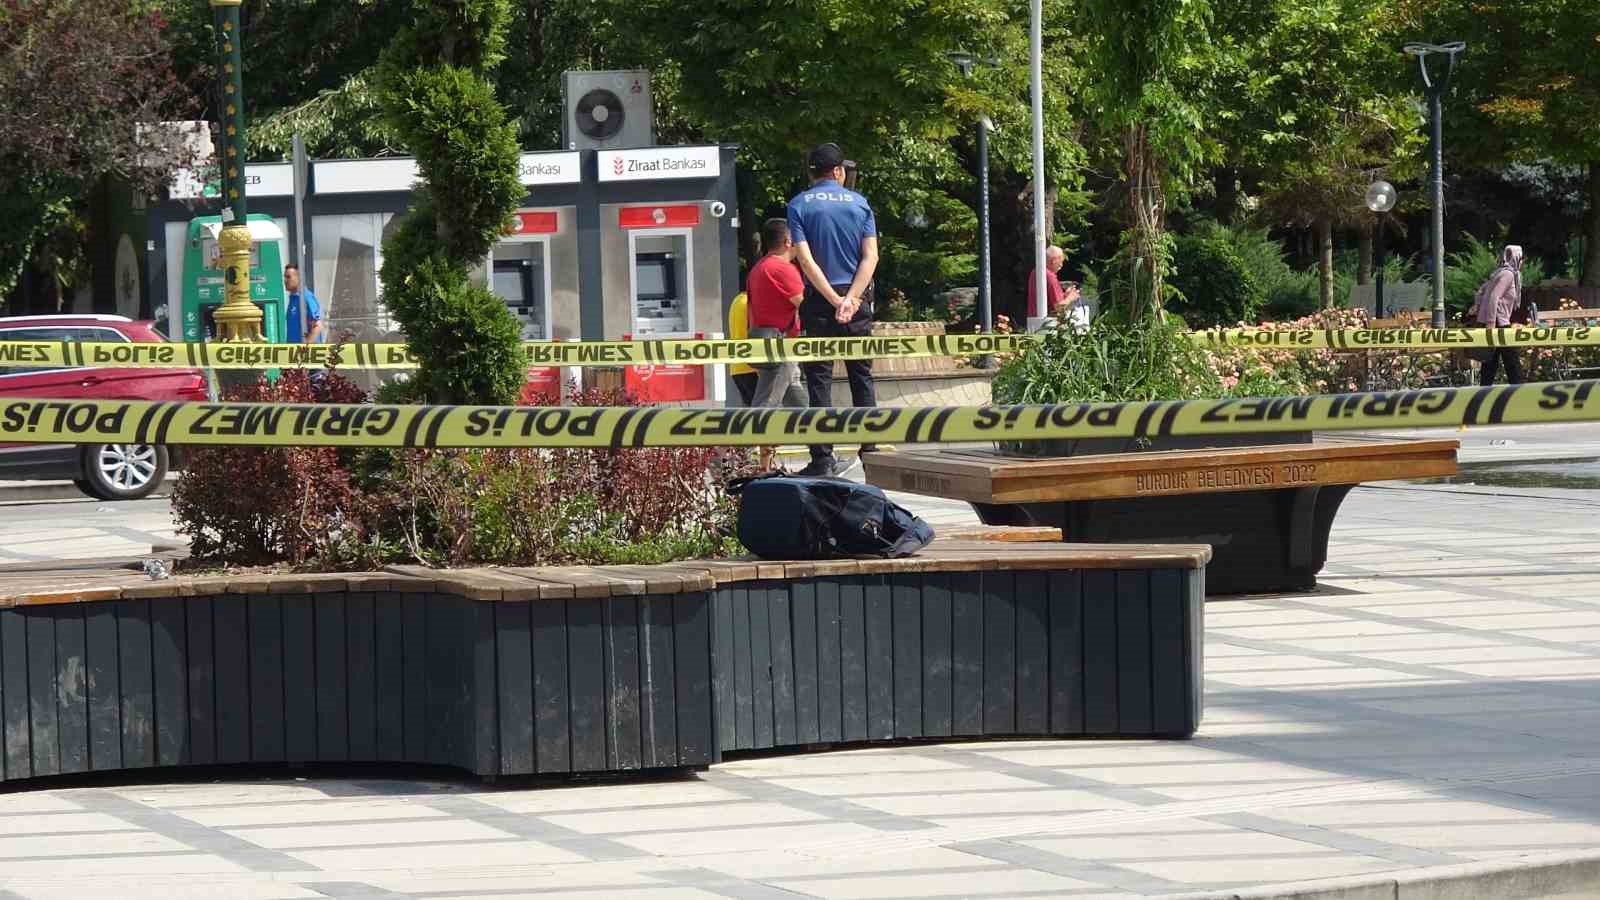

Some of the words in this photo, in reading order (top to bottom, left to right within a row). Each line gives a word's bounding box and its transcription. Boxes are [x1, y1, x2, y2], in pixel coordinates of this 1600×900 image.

[628, 160, 660, 172] Ziraat
[662, 157, 706, 170] Bankası
[244, 175, 261, 185] EB
[1, 402, 130, 433] POLİS
[188, 404, 399, 435] GİRİLMEZ
[464, 408, 604, 437] POLİS
[1136, 471, 1190, 491] BURDUR
[1282, 464, 1317, 482] 2022
